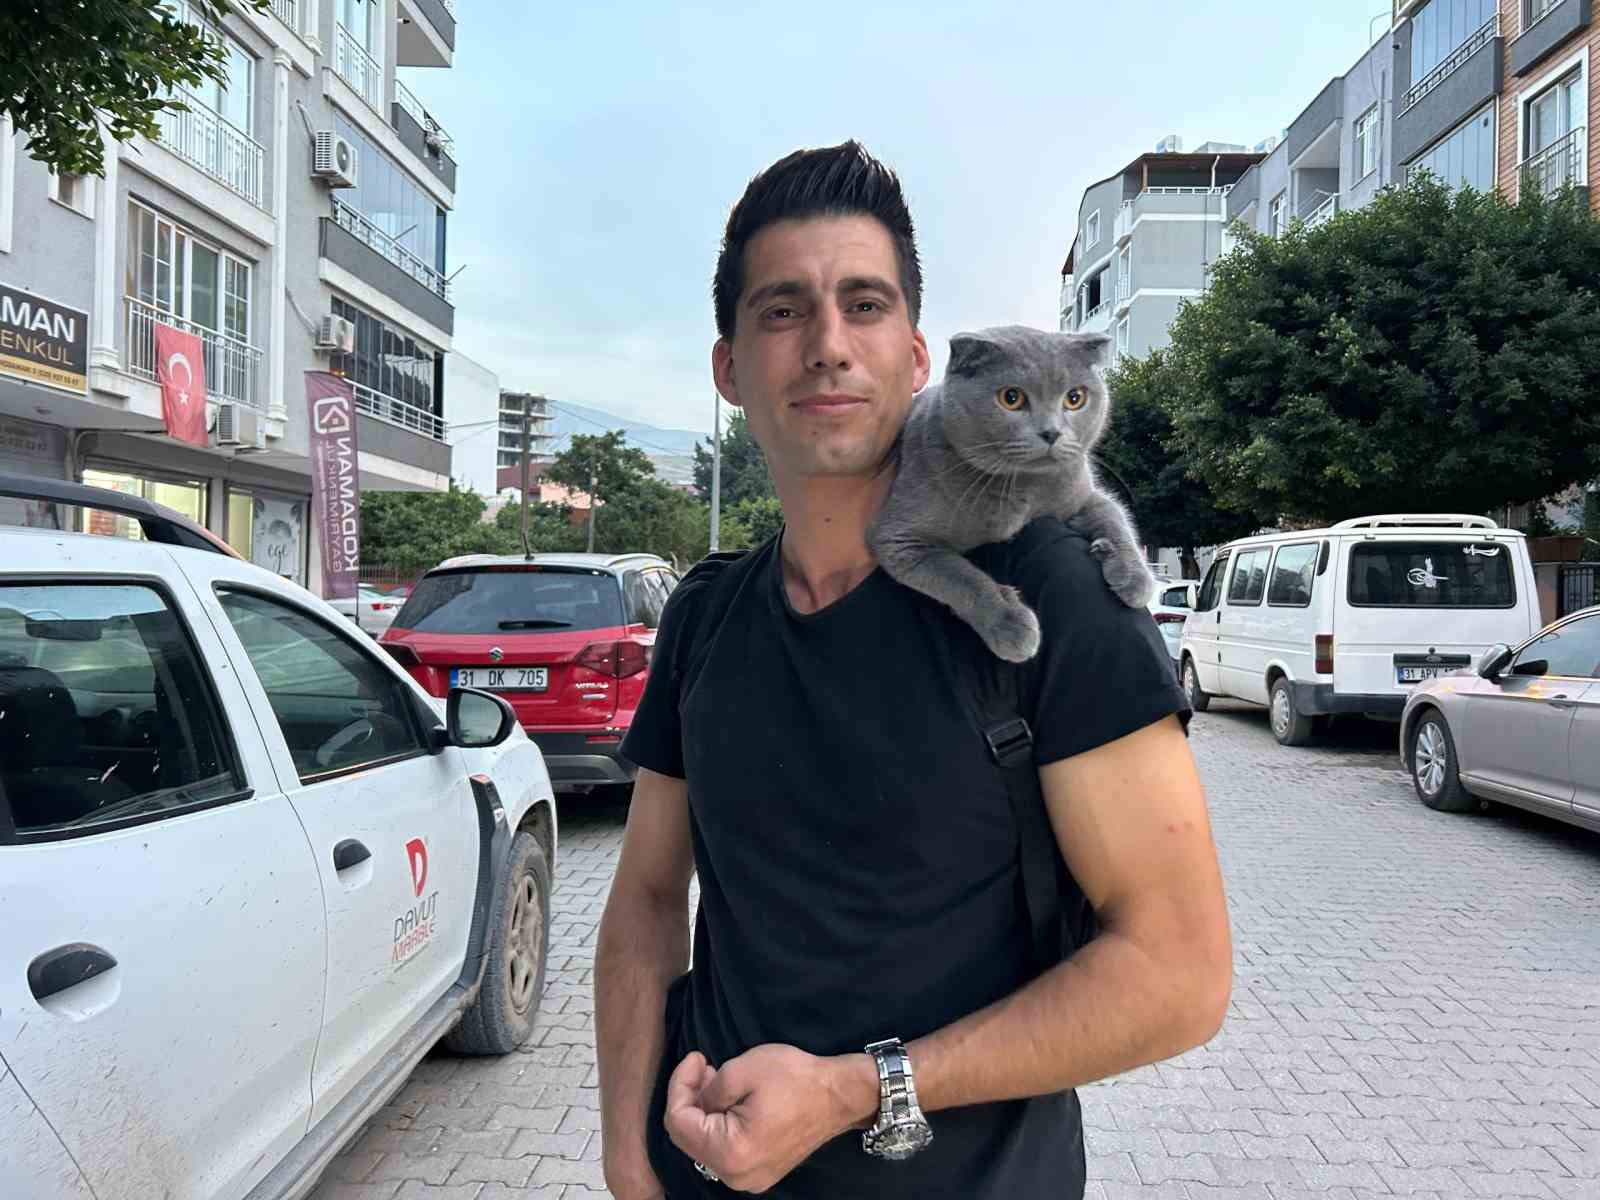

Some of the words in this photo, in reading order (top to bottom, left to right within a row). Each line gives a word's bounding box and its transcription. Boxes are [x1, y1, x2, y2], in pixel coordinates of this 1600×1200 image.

[0, 295, 75, 343] MAN
[460, 670, 474, 687] 31
[489, 670, 505, 686] DK
[519, 670, 544, 686] 705
[1404, 668, 1416, 680] 31
[394, 890, 439, 943] DAVUT
